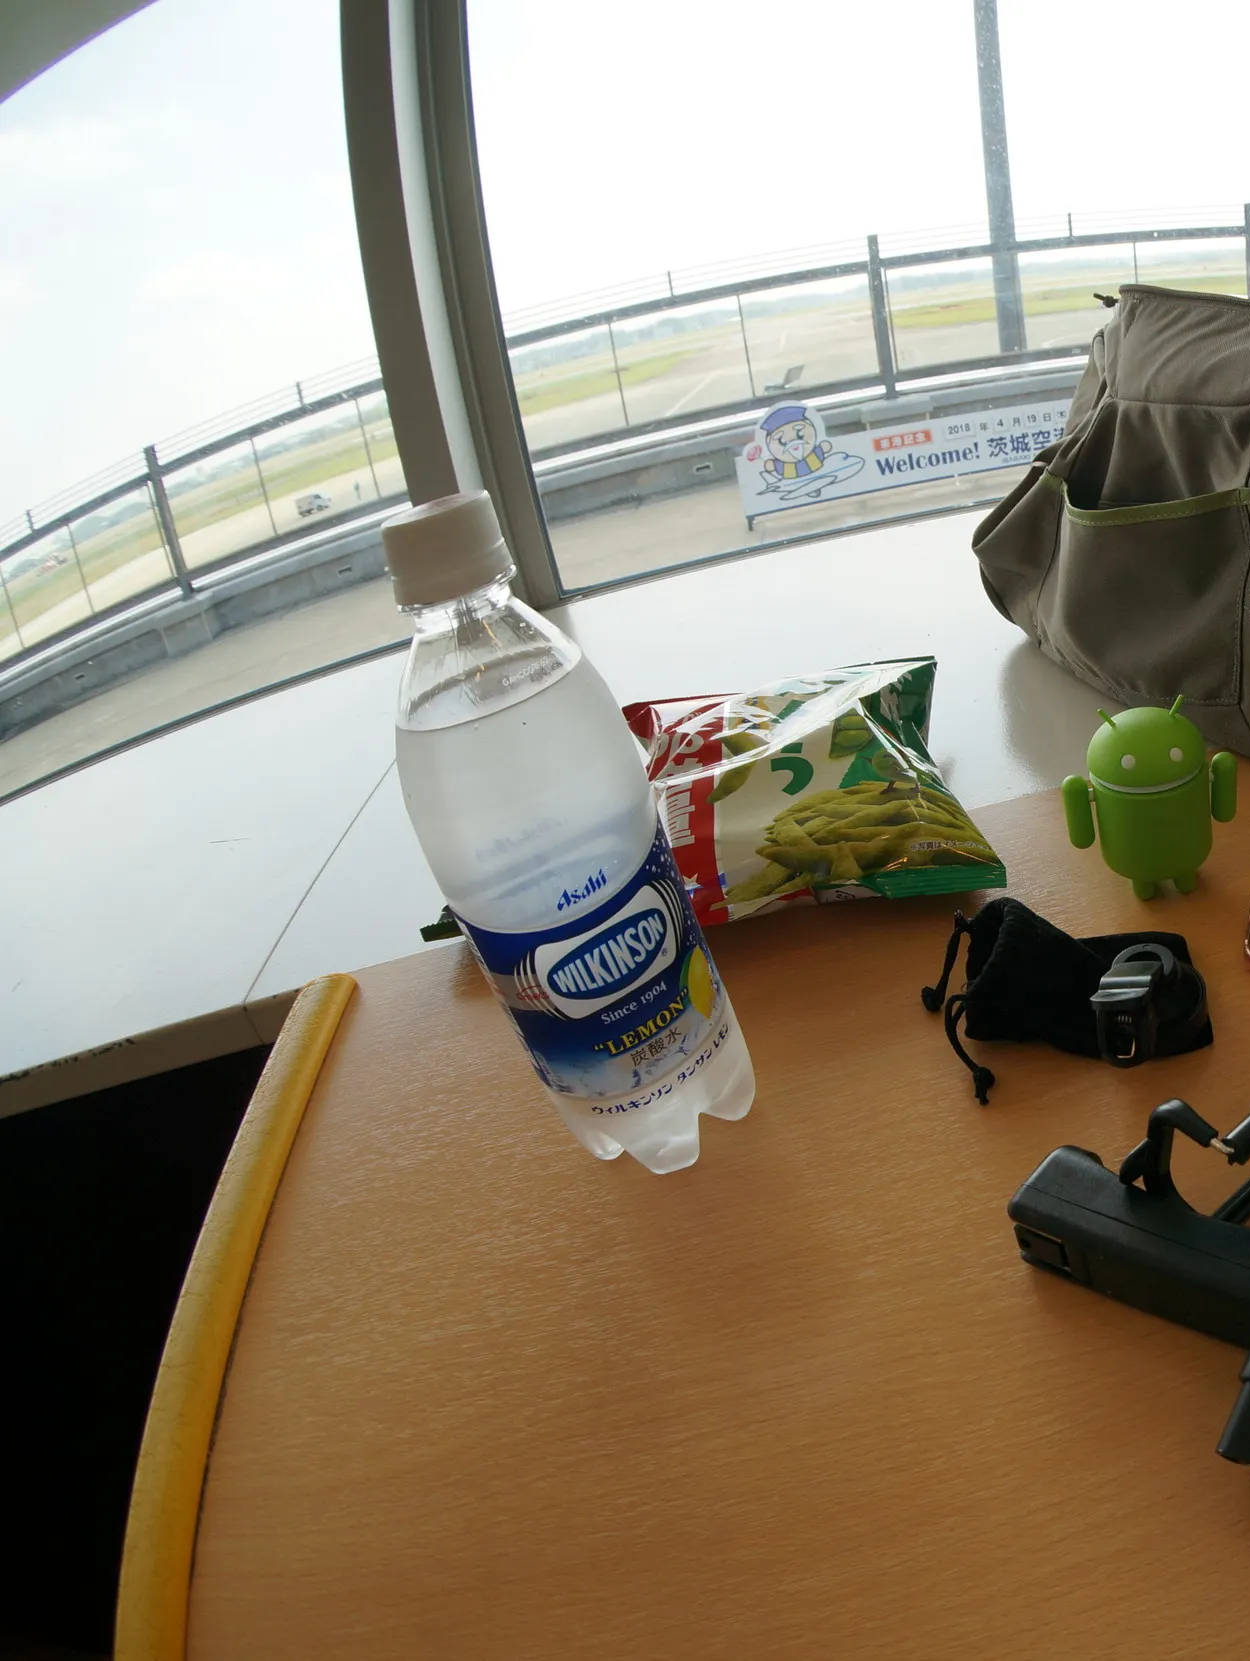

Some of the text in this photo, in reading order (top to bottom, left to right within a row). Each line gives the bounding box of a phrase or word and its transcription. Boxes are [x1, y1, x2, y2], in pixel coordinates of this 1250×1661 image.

[948, 423, 971, 435] 2018
[979, 422, 988, 432] 年
[996, 419, 1004, 427] 4
[1012, 417, 1021, 426] 月
[1026, 414, 1037, 423] 19
[1043, 413, 1052, 422] 日
[875, 442, 980, 476] Welcome!
[557, 868, 607, 912] Asahi
[552, 913, 664, 993] WILKINSON
[601, 980, 668, 1025] Since 1904
[630, 1027, 682, 1066] 炭酸水
[591, 1023, 730, 1115] ウィルキンソン タンサン レモン
